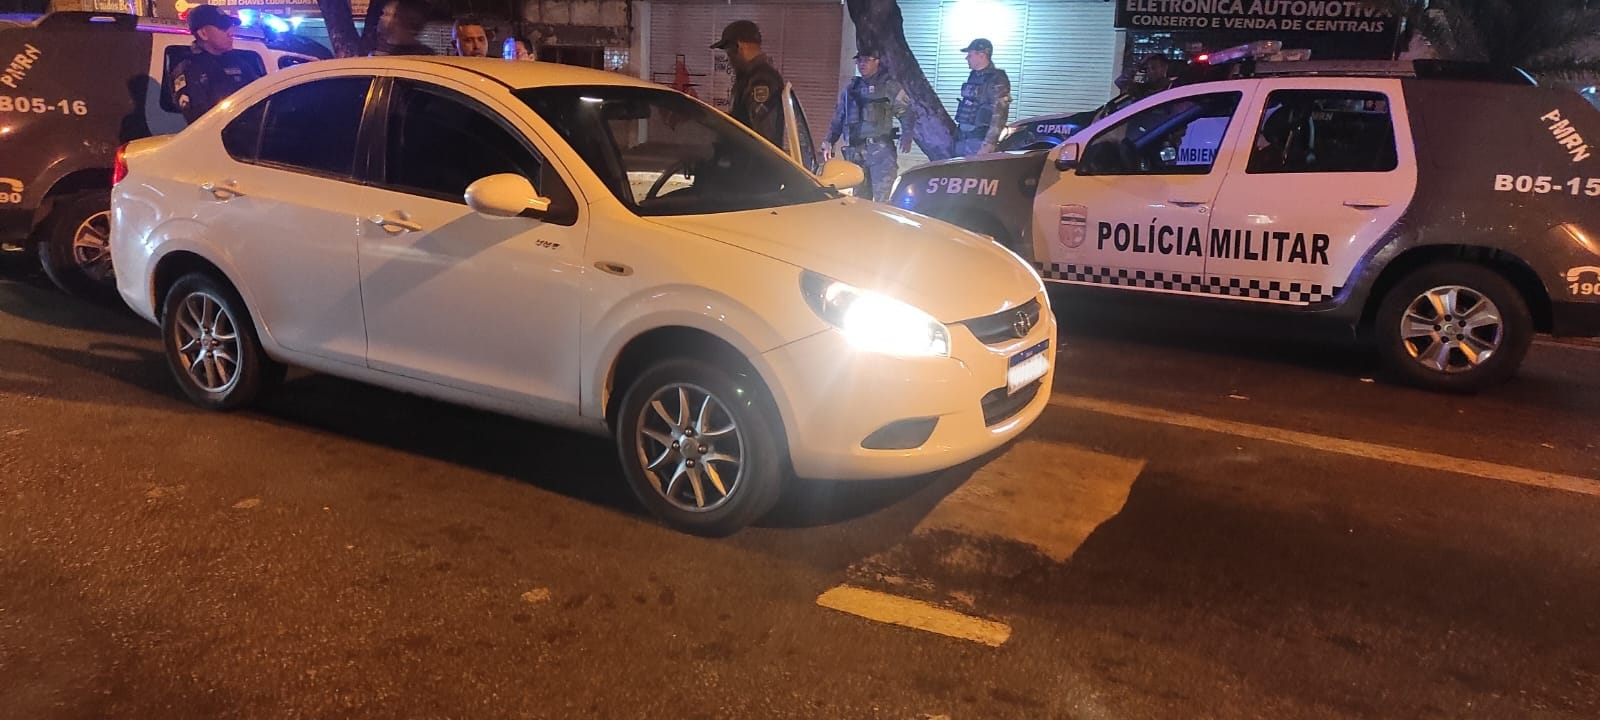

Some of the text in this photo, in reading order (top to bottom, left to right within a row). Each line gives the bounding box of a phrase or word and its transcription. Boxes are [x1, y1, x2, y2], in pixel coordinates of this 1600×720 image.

[1131, 15, 1385, 33] CONSERTO E VENDA DE CENTRAIS
[0, 43, 42, 89] PMRN
[0, 95, 88, 116] B05-16
[1036, 124, 1072, 135] CIPAM
[1540, 108, 1591, 162] PMRN
[1494, 174, 1600, 197] B05-15
[1097, 217, 1331, 266] POLÍCIA MILITAR
